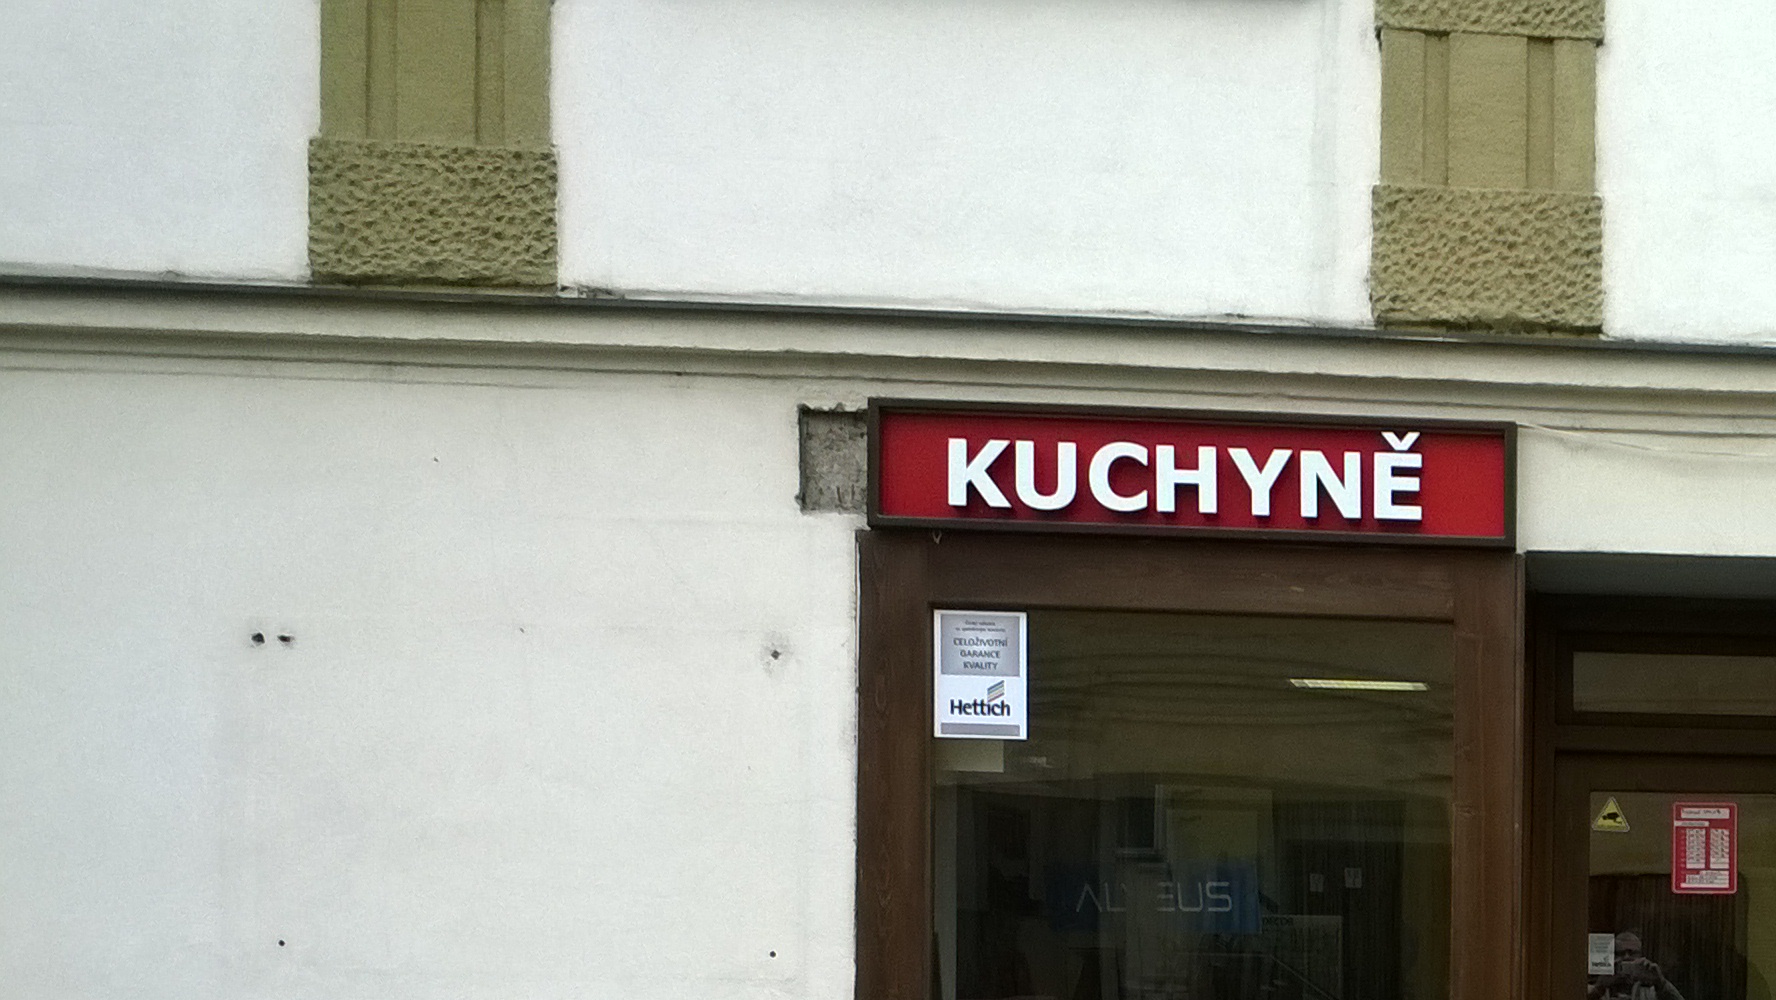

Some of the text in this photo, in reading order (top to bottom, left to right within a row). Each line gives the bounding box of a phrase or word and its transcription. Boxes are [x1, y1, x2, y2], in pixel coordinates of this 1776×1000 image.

[947, 431, 1423, 522] KUCHYNĚ
[953, 636, 1008, 647] CELOŽIVOTNÍ
[959, 649, 1001, 659] GARANCE
[963, 661, 998, 670] KVALITY
[950, 698, 1011, 717] Hettich
[1076, 881, 1233, 913] ALEUS
